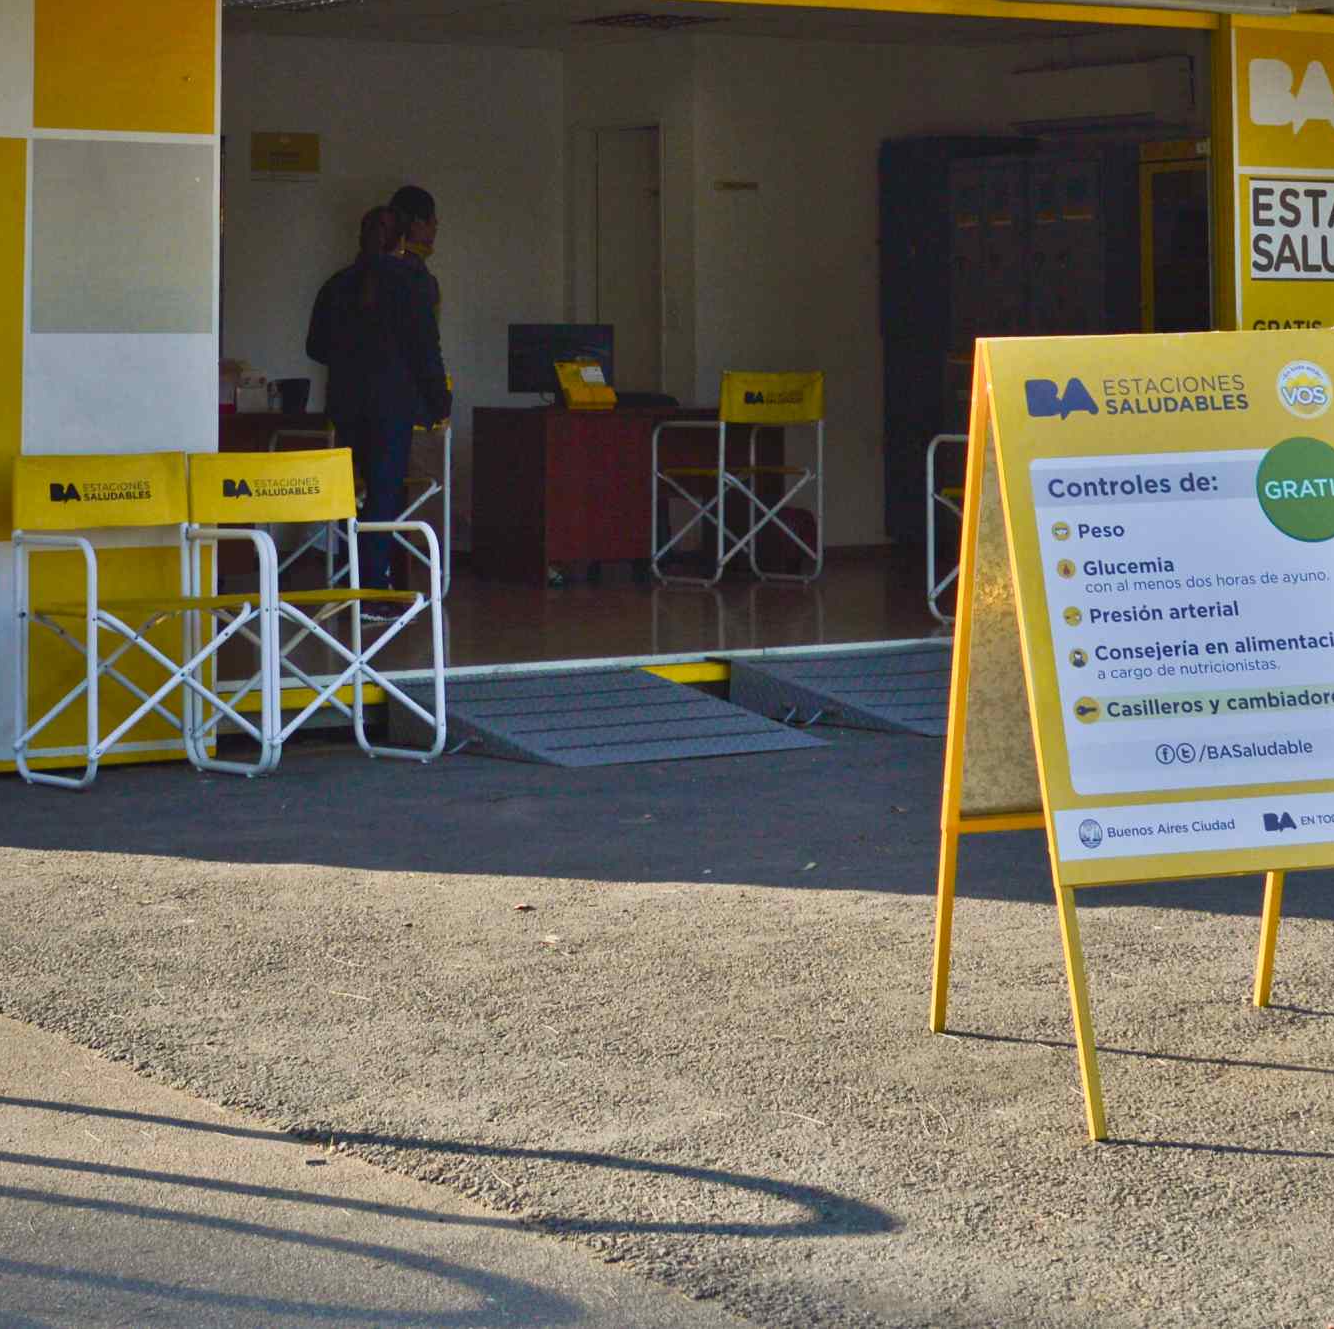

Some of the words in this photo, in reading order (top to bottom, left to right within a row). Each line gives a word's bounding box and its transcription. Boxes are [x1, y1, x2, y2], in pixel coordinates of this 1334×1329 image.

[1103, 374, 1245, 397] ESTACIONES
[1281, 385, 1328, 407] VOS
[1025, 378, 1099, 420] BA
[1106, 394, 1249, 416] SALUDABLES
[50, 483, 81, 503] BA
[83, 490, 152, 502] SALUDABLES
[223, 478, 252, 499] BA
[254, 486, 320, 498] SALUDABLES
[1048, 475, 1171, 499] Controles
[1179, 472, 1218, 495] de:
[1078, 523, 1125, 539] Peso
[1083, 557, 1175, 576] Glucemia
[1085, 581, 1113, 594] con
[1117, 579, 1129, 592] al
[1133, 577, 1181, 591] menos
[1186, 574, 1212, 588] dos
[1216, 572, 1256, 586] horas
[1260, 570, 1279, 584] de
[1282, 569, 1330, 585] ayuno.
[1089, 605, 1163, 624] Presión
[1169, 600, 1239, 620] arterial
[1205, 641, 1229, 655] en
[1097, 670, 1106, 680] a
[1110, 667, 1153, 681] cargo
[1157, 664, 1175, 677] de
[1180, 657, 1282, 676] nutricionistas.
[1107, 695, 1203, 718] Casilleros
[1209, 697, 1220, 715] y
[1199, 740, 1314, 763] /BASaludable
[1107, 825, 1154, 839] Buenos
[1157, 822, 1189, 836] Aires
[1192, 818, 1236, 833] Ciudad
[1263, 812, 1298, 832] BA
[1300, 815, 1315, 825] EN
